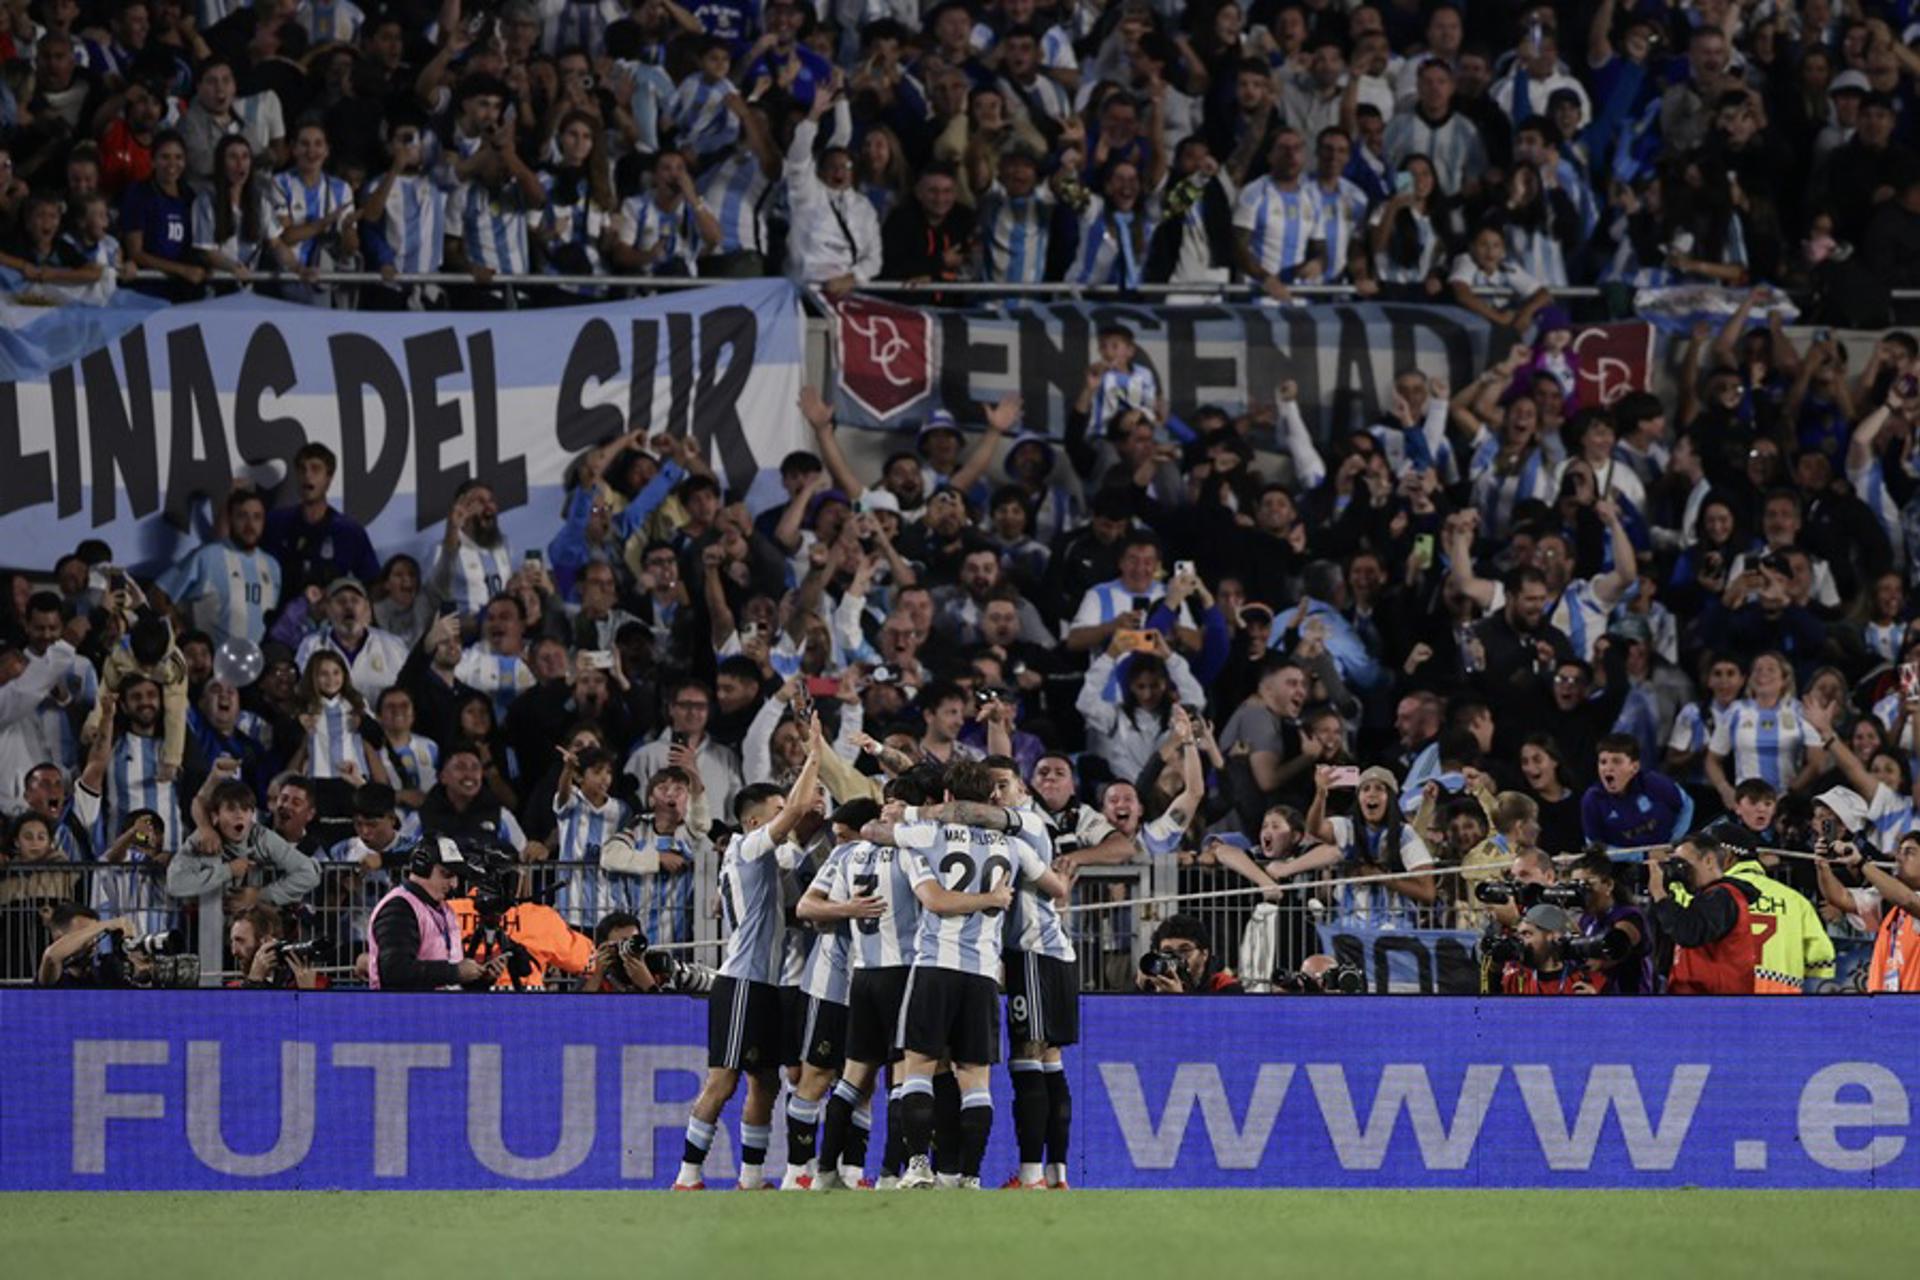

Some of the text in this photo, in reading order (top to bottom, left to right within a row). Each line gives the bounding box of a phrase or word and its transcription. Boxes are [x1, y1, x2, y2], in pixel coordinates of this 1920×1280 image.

[167, 221, 185, 243] 10
[0, 304, 759, 534] LINAS DEL SUR
[245, 582, 262, 605] 10
[944, 829, 968, 843] MAC
[939, 852, 1013, 917] 20
